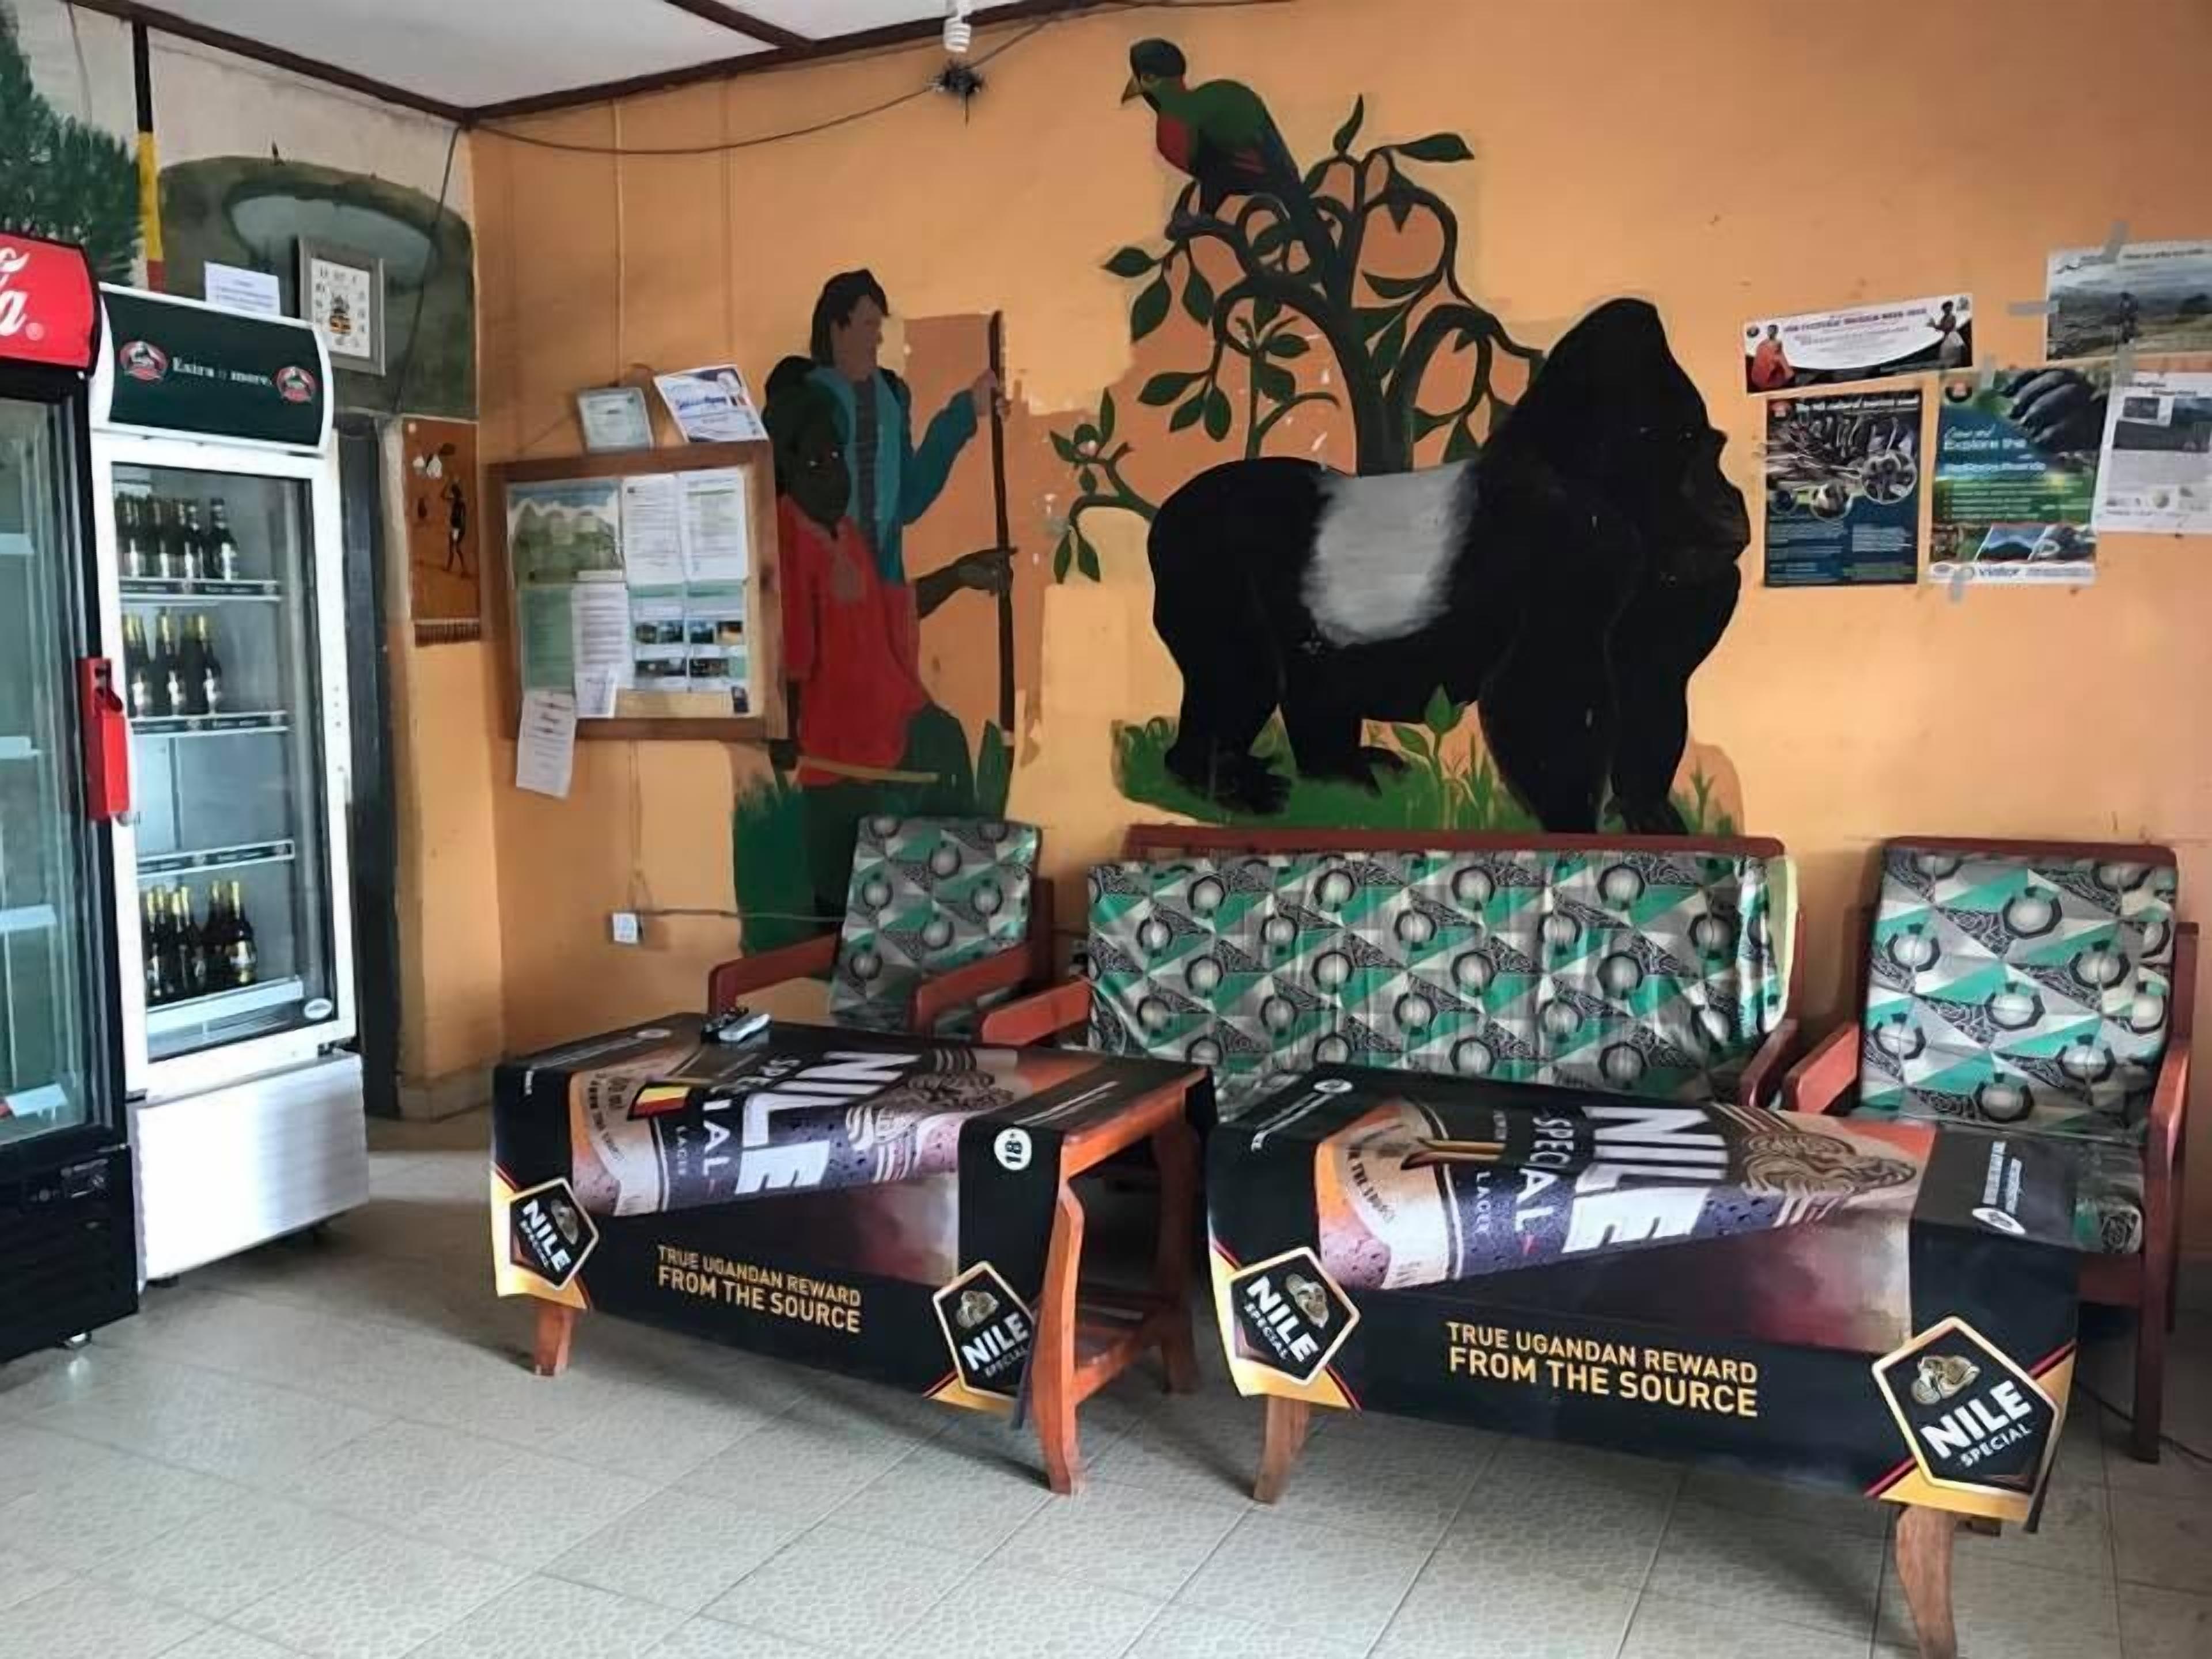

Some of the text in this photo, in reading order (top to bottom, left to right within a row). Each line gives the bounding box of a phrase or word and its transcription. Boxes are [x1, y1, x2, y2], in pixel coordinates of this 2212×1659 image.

[734, 1050, 922, 1195] NILE
[1562, 1106, 1728, 1253] NILE
[522, 1199, 572, 1272] NILE
[657, 1244, 861, 1307] TRUE UGANDAN REWARD
[658, 1265, 861, 1334] FROM THE SOURCE
[961, 1312, 1029, 1372] NILE
[1246, 1275, 1320, 1362] NILE
[1445, 1321, 1759, 1384] TRUE UGANDAN REWARD
[1449, 1346, 1759, 1418] FROM THE SOURCE
[1919, 1380, 2032, 1459] NILE
[1960, 1422, 2033, 1468] SPECIAL
